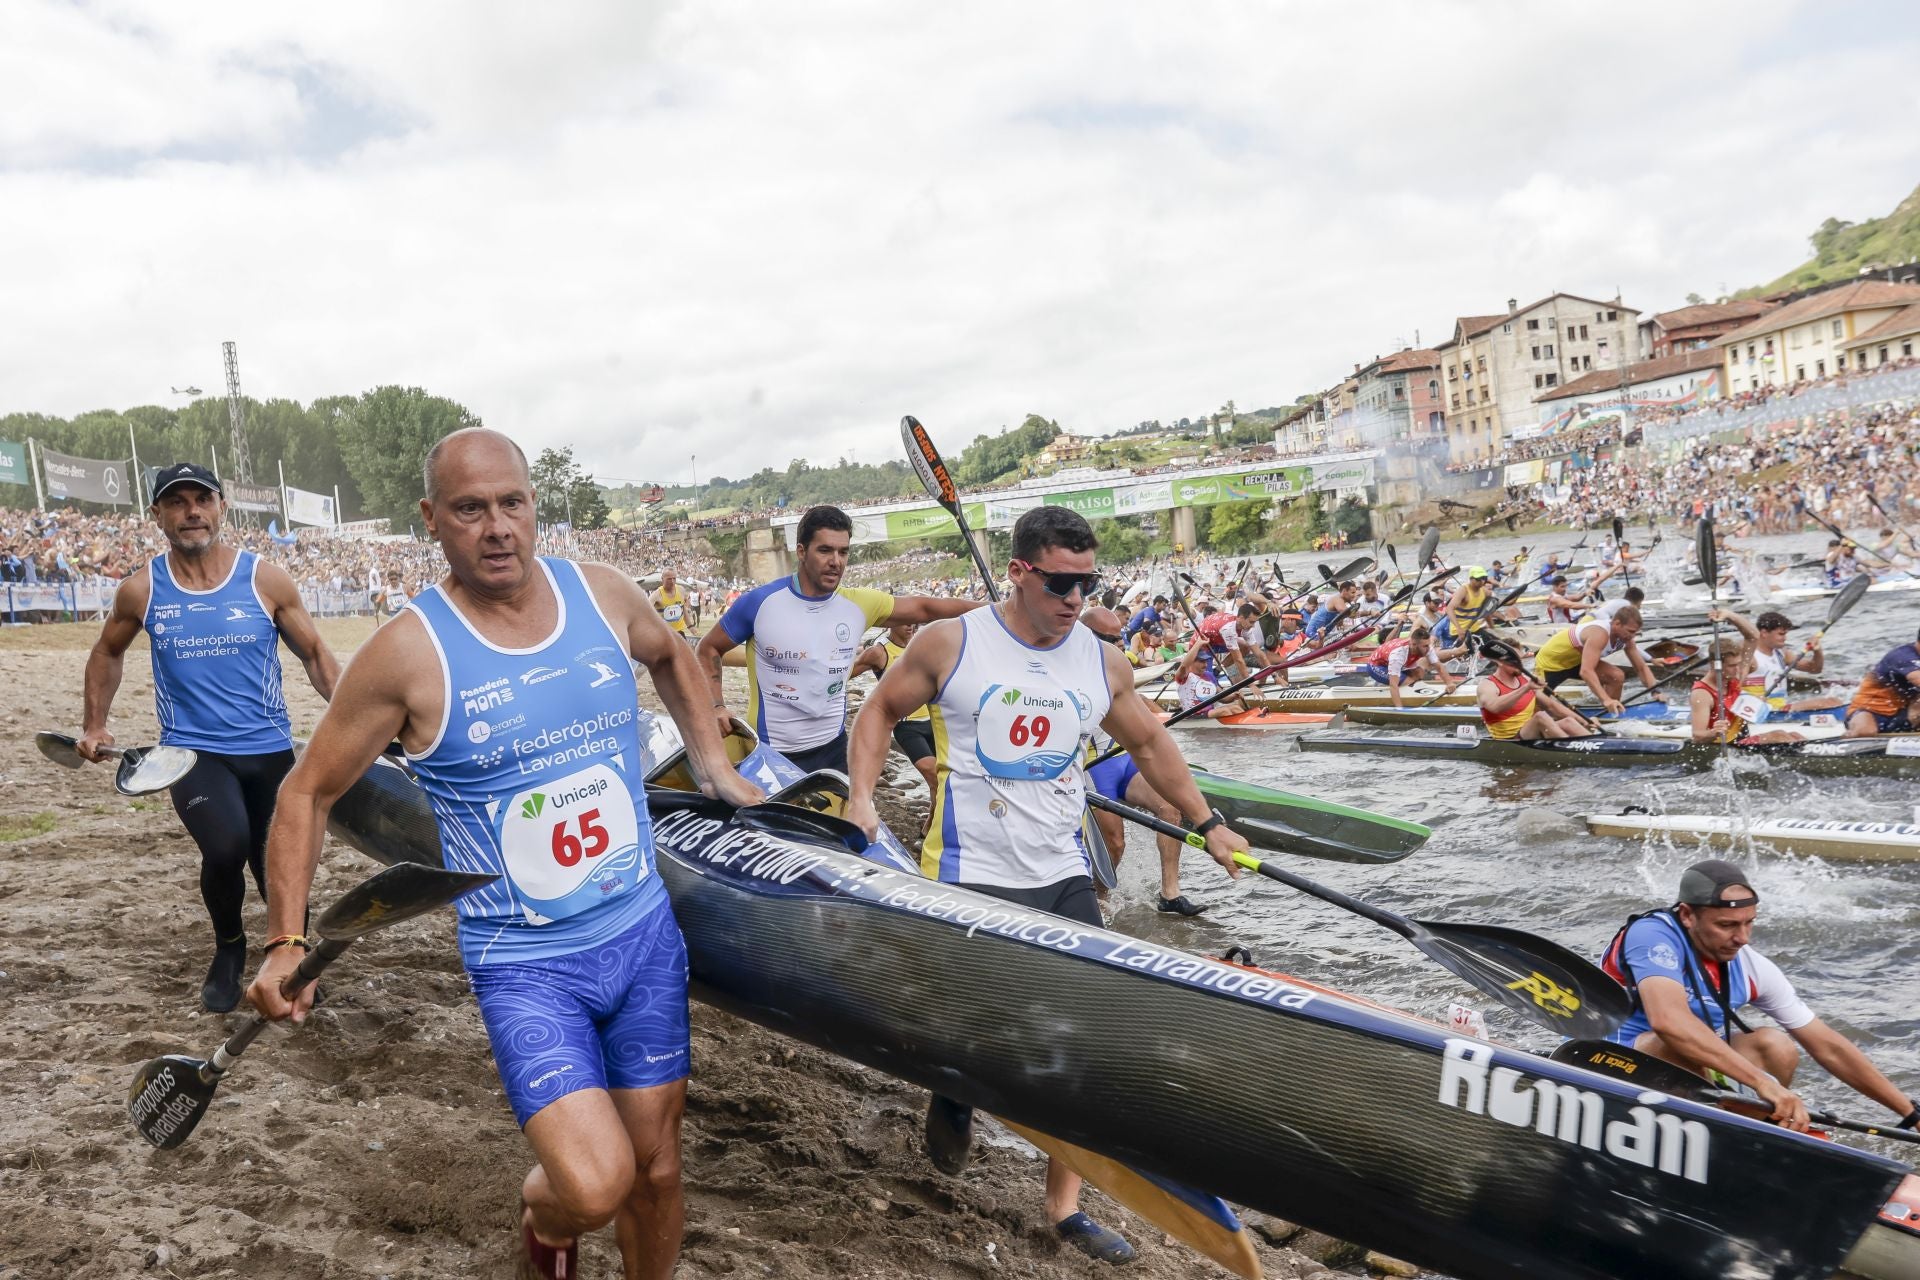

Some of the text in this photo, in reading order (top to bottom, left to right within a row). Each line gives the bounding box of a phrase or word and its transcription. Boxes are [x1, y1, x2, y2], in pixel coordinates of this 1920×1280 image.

[911, 447, 931, 482] TOYOTA
[1244, 473, 1278, 485] RECICLA
[1324, 468, 1363, 480] ecopilas
[1267, 481, 1291, 491] PILAS
[1046, 496, 1112, 510] RAÍSO
[173, 633, 257, 649] federópticos
[175, 646, 239, 660] Lavandera
[1202, 686, 1211, 695] 23
[1023, 696, 1064, 710] Unicaja
[1815, 715, 1828, 724] 20
[512, 707, 632, 758] federópticos
[1009, 714, 1051, 748] 69
[1462, 726, 1471, 734] 19
[1566, 741, 1605, 751] SONIC
[1800, 743, 1848, 755] SONIC
[517, 734, 619, 776] Lavandera
[551, 776, 609, 809] Unicaja
[551, 807, 610, 868] 65
[653, 808, 830, 885] CLUB NEPTUNO
[600, 876, 623, 892] SELLA
[878, 883, 1319, 1010] federópticos Lavandera
[1455, 1007, 1472, 1025] 37
[1588, 1052, 1607, 1064] IV
[141, 1092, 200, 1147] Lavandera
